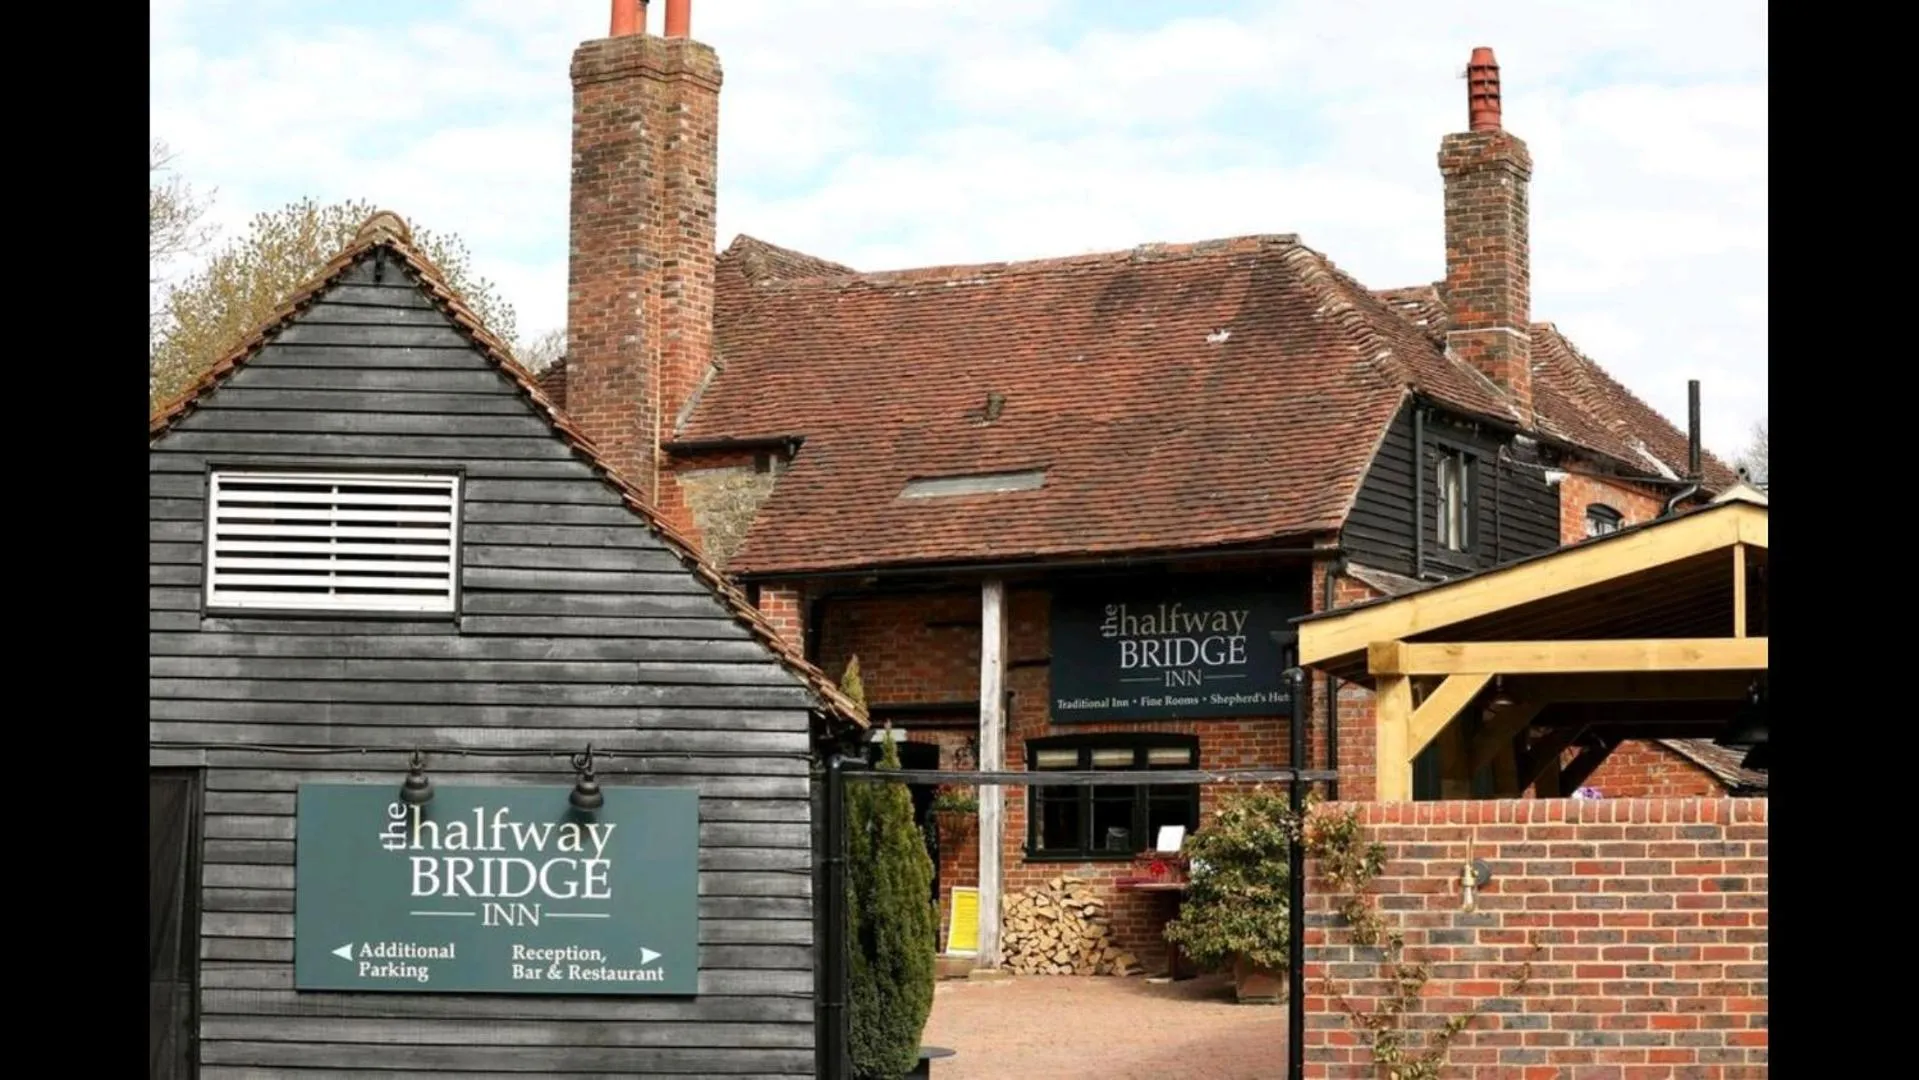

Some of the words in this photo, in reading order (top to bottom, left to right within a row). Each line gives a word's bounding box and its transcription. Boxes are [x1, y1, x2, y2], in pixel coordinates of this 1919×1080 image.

[1100, 604, 1118, 638] the
[1119, 603, 1250, 636] halfway
[1119, 635, 1248, 669] BRIDGE
[1164, 669, 1202, 687] INN
[1057, 698, 1109, 709] Traditional
[1112, 698, 1129, 707] Inn
[1140, 696, 1162, 707] Fine
[1164, 695, 1199, 706] Rooms
[1210, 693, 1266, 706] Shepherd's
[379, 802, 407, 852] the
[409, 804, 616, 860] halfway
[409, 857, 612, 899] BRIDGE
[481, 903, 542, 927] INN
[359, 942, 455, 960] Additional
[512, 945, 607, 969] Reception,
[359, 962, 429, 981] Parking
[512, 964, 541, 980] Bar
[547, 964, 564, 980] &
[569, 965, 665, 981] Restaurant
